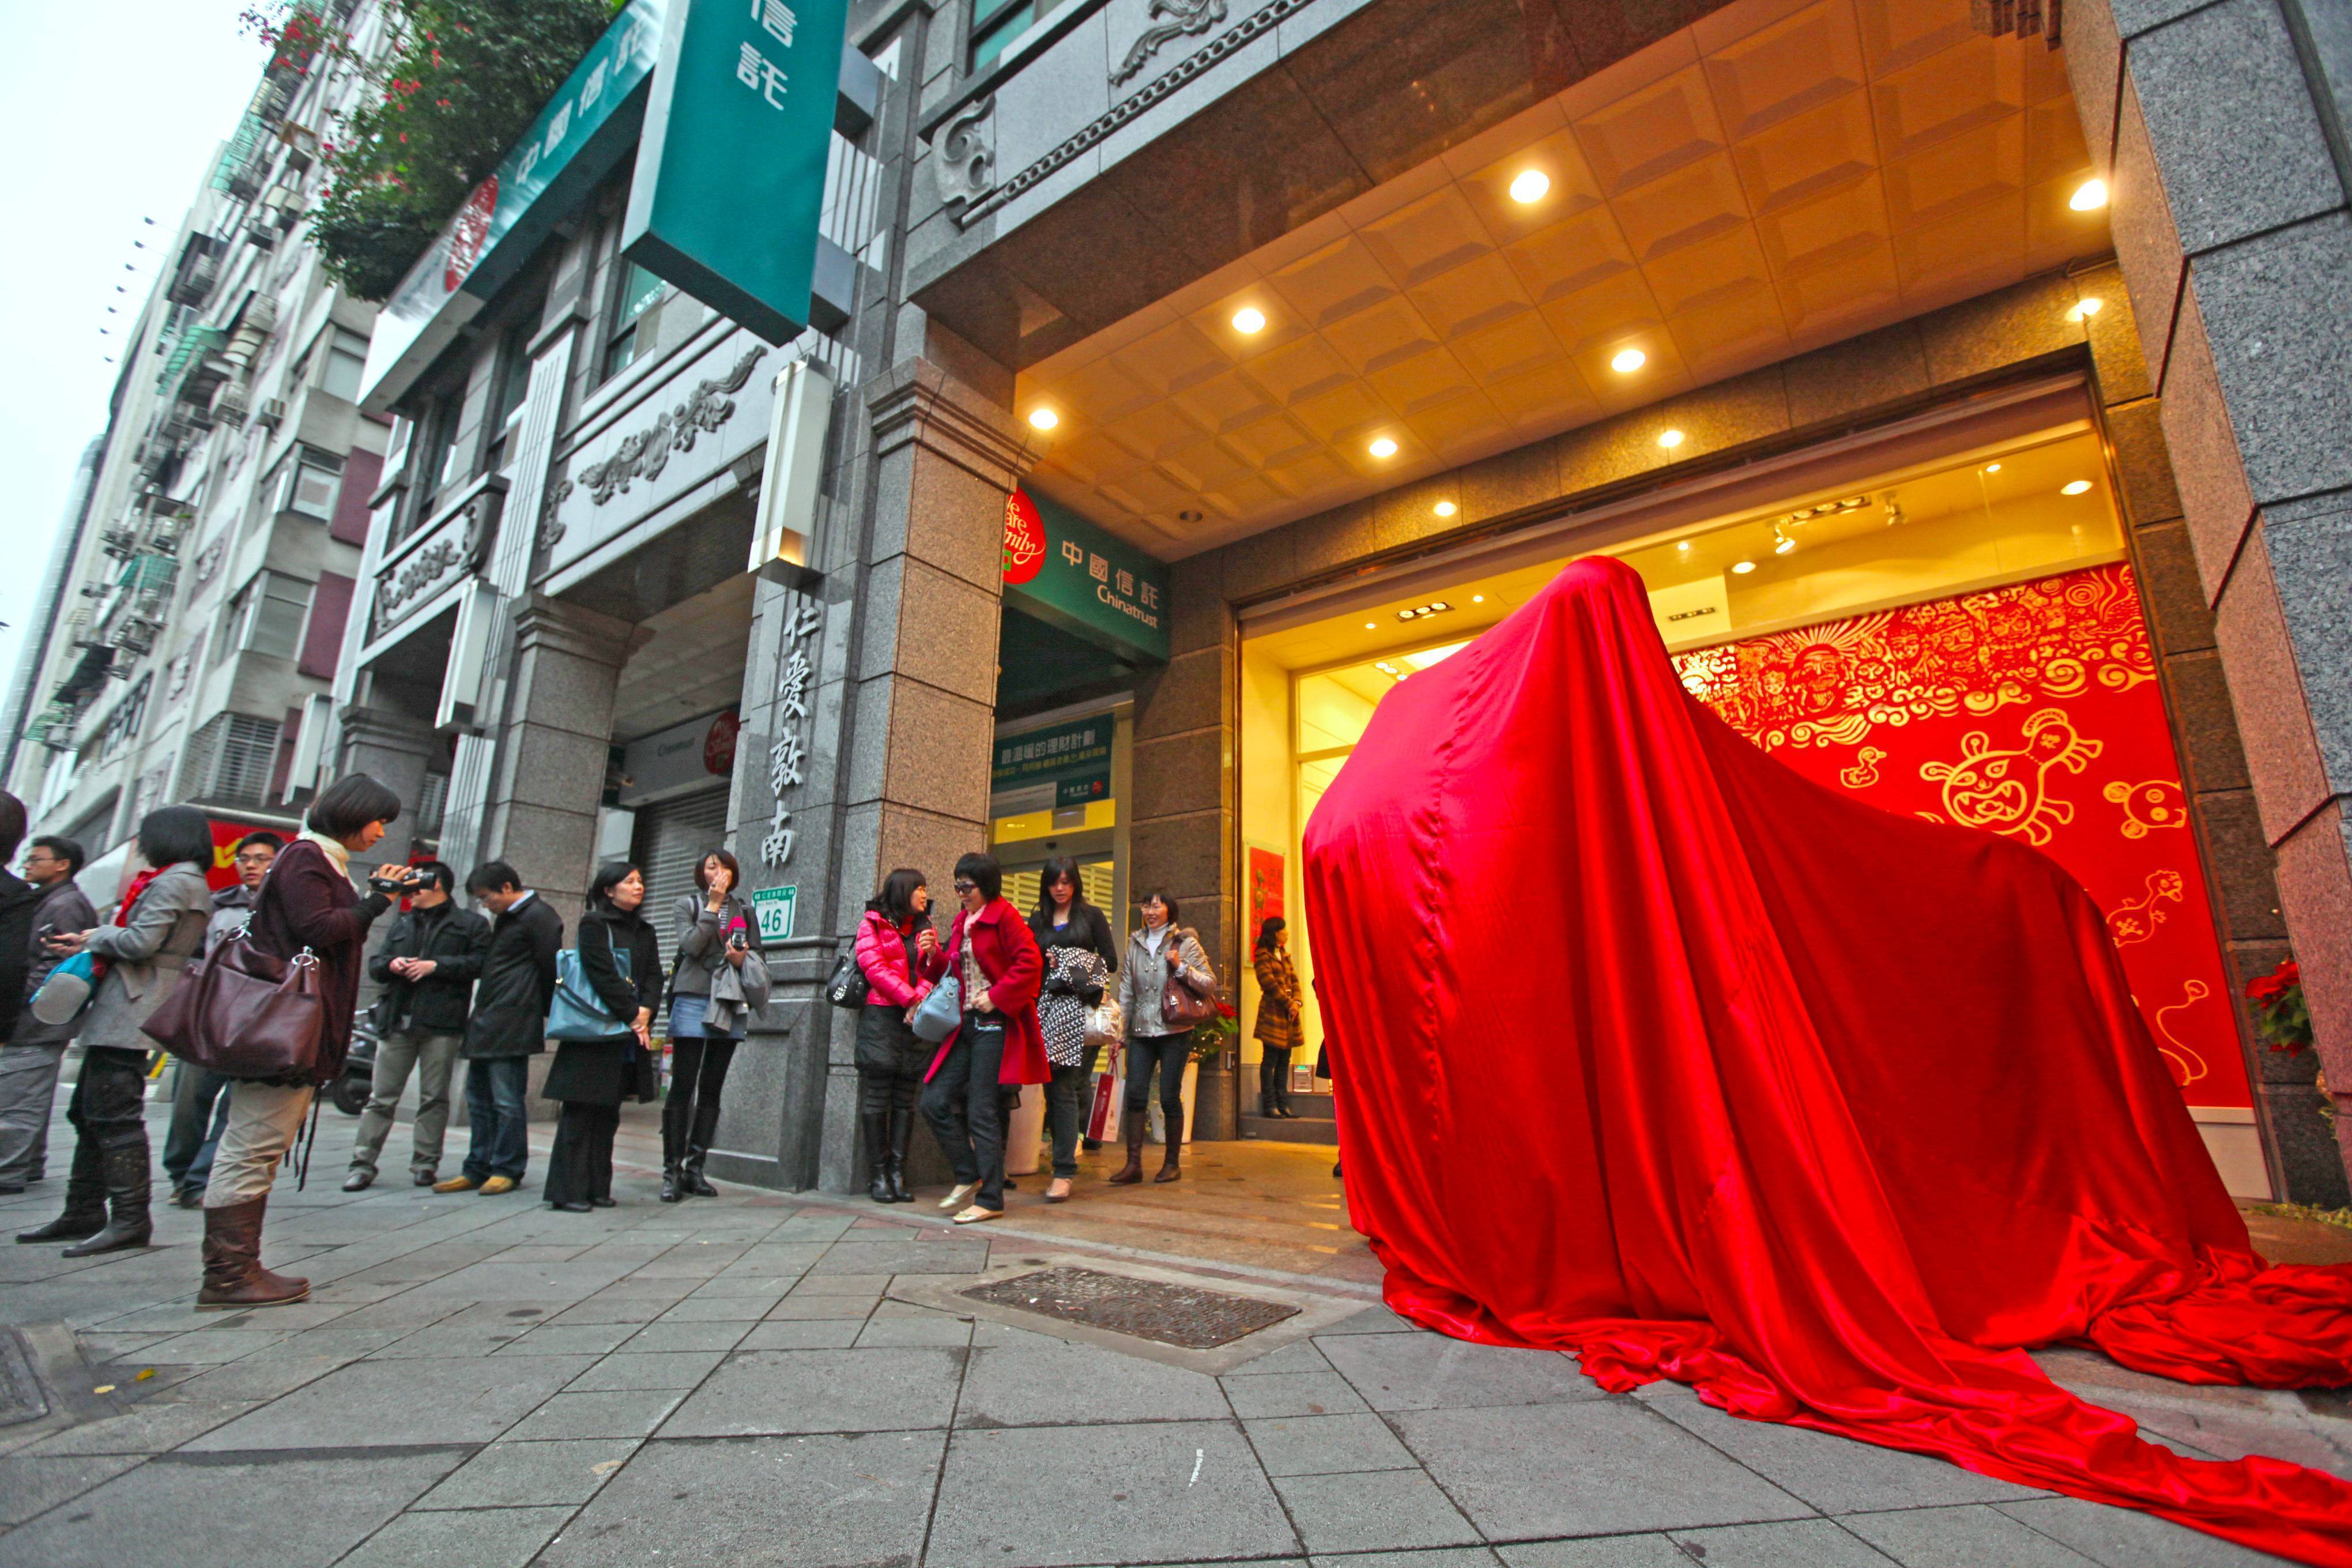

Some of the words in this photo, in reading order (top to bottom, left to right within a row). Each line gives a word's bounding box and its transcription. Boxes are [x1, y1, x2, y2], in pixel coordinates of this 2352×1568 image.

[1005, 529, 1046, 565] mily
[1062, 540, 1158, 609] 中國信託
[1097, 585, 1158, 628] Chinatrust
[762, 909, 782, 933] 46
